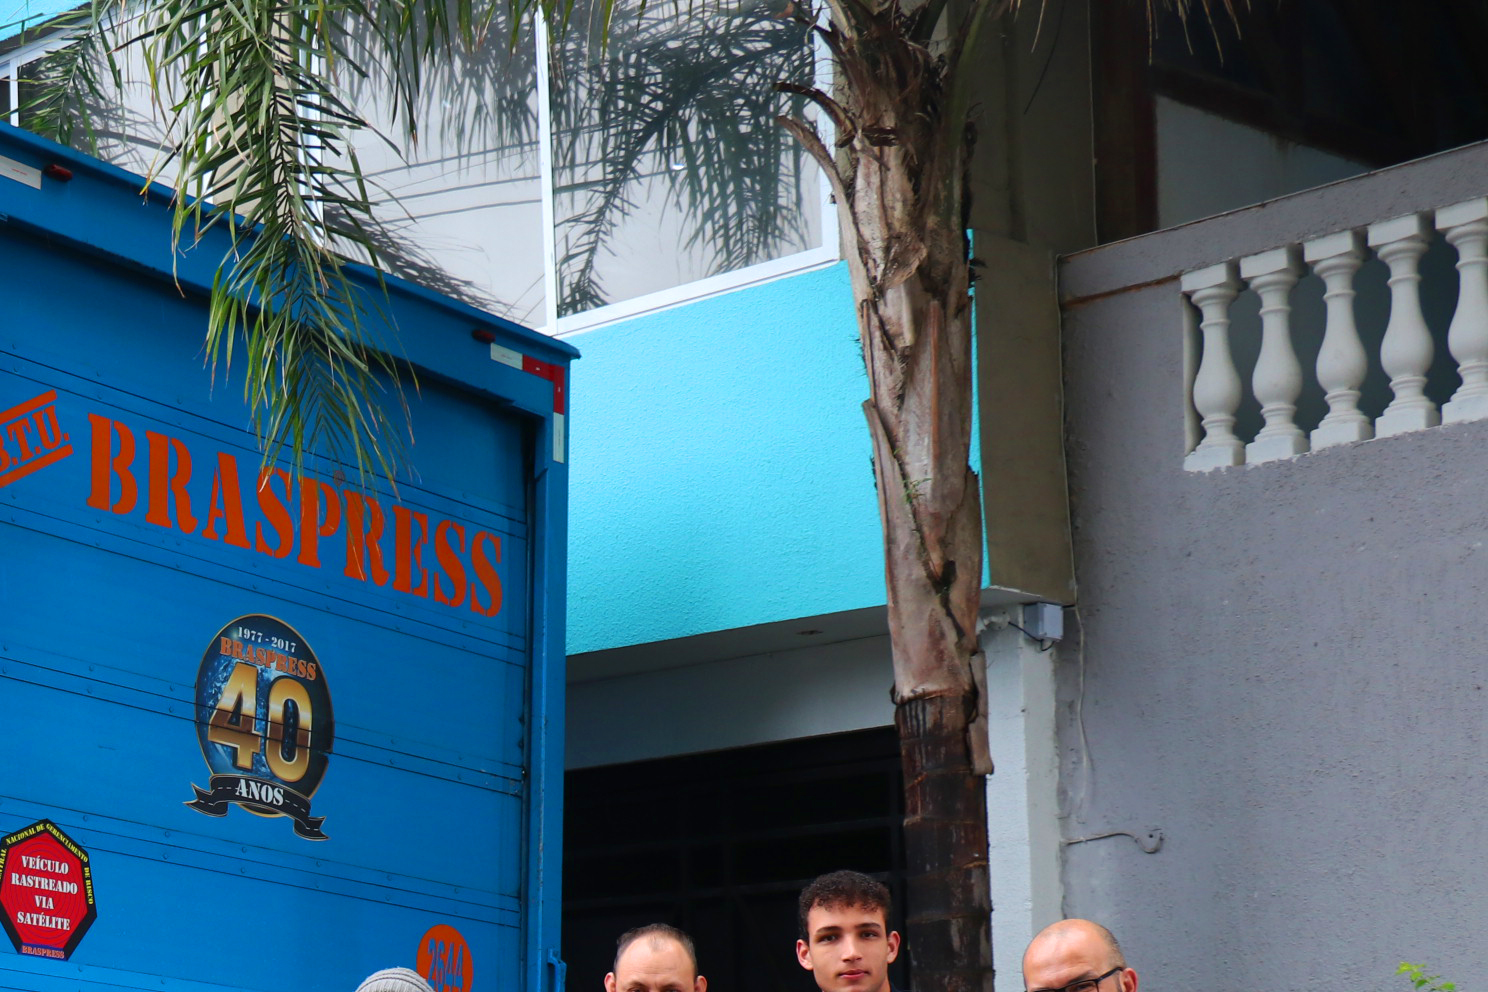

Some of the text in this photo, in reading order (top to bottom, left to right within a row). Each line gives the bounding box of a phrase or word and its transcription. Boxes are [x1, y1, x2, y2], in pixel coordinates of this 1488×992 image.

[86, 412, 503, 617] BRASPRESS
[238, 627, 263, 643] 1977
[271, 636, 297, 653] 2017
[220, 636, 317, 681] BRASPRESS
[208, 662, 312, 782] 40
[235, 778, 284, 806] ANOS
[6, 828, 36, 845] NACIONAL
[36, 823, 45, 832] DE
[46, 823, 88, 863] GERENCIAMENTO
[22, 855, 69, 875] VEÍCULO
[84, 867, 90, 878] DE
[11, 873, 78, 895] RASTREADO
[85, 880, 94, 905] RISCO
[35, 895, 54, 909] VIA
[17, 911, 70, 931] SATÉLITE
[22, 946, 65, 959] BRASPRESS
